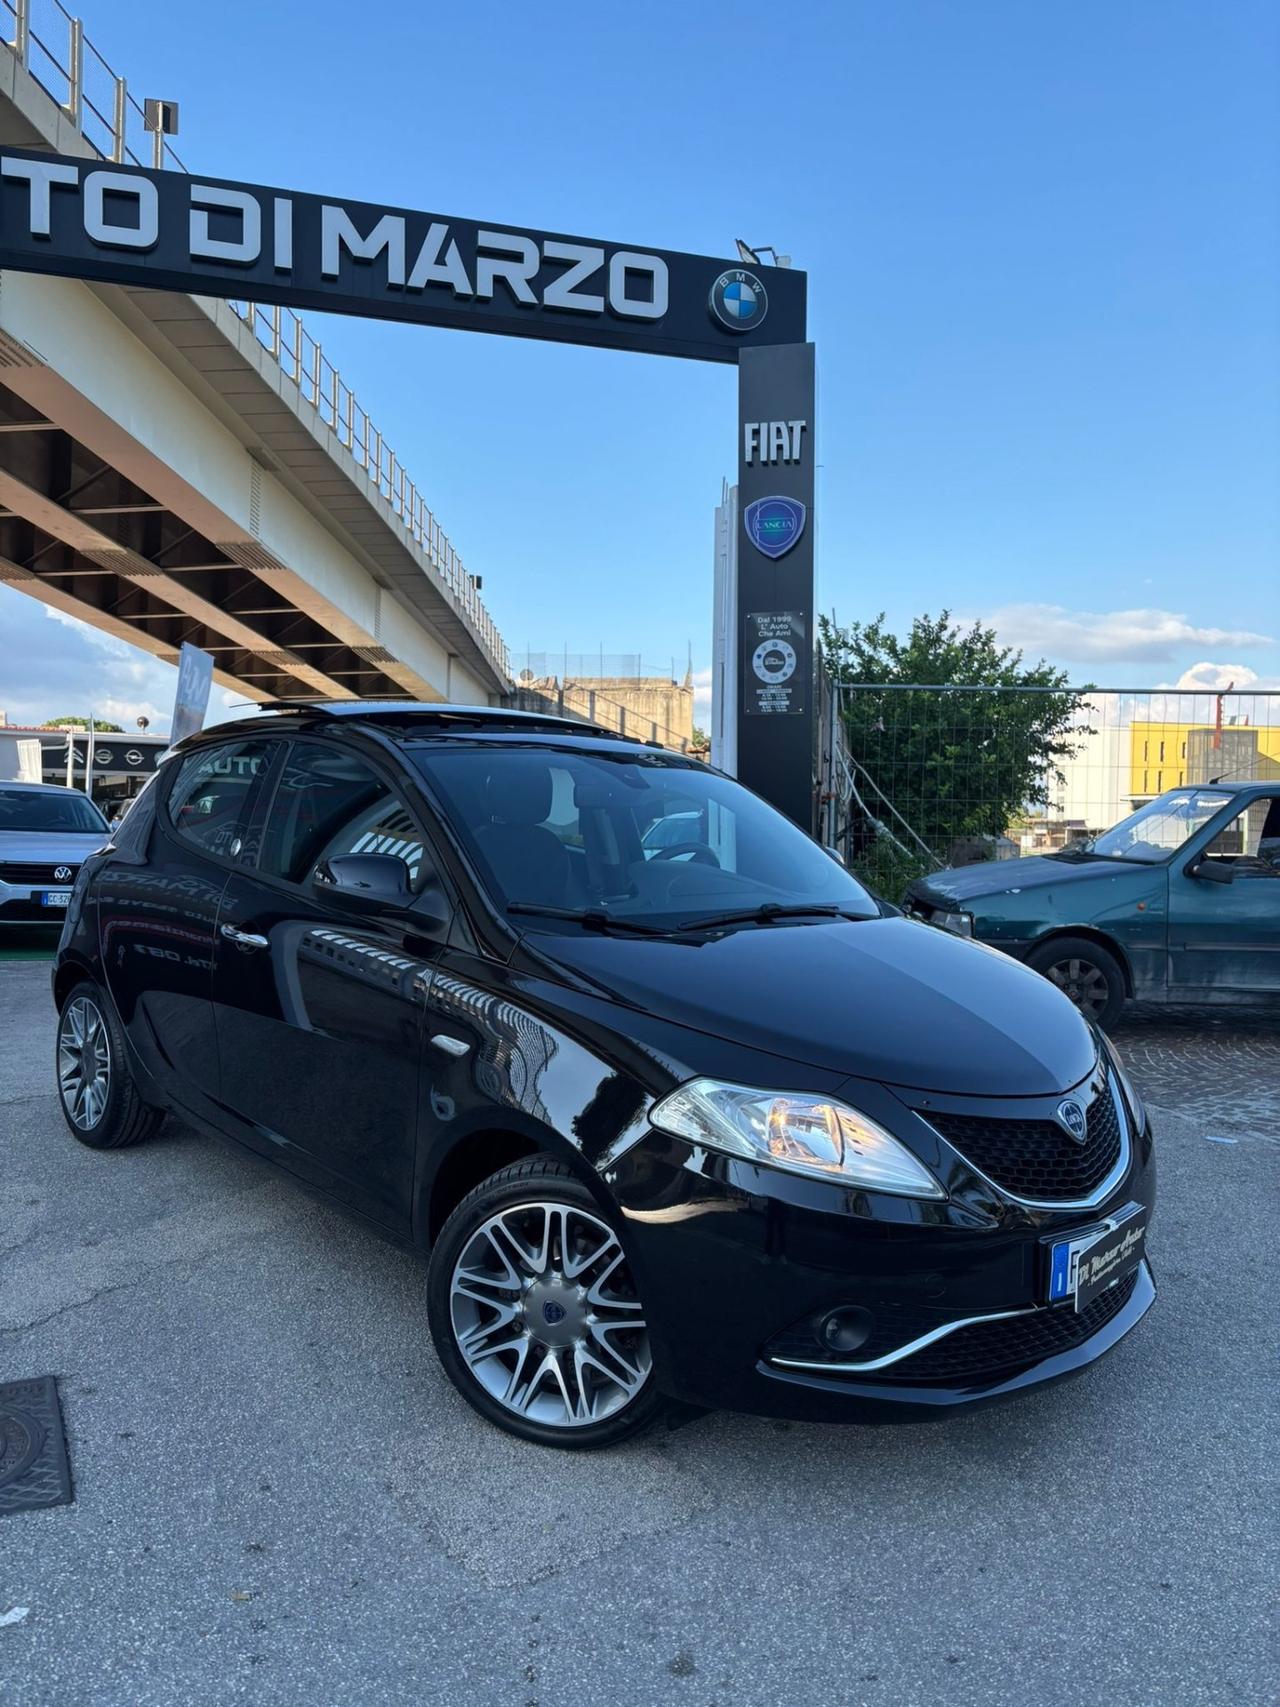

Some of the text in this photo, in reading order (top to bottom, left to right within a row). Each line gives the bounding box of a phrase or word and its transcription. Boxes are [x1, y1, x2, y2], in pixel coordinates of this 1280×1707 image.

[189, 183, 293, 269] DI
[321, 204, 669, 319] MARZO
[720, 272, 762, 293] BMW
[744, 420, 806, 462] FIAT
[757, 520, 793, 530] LANCIA
